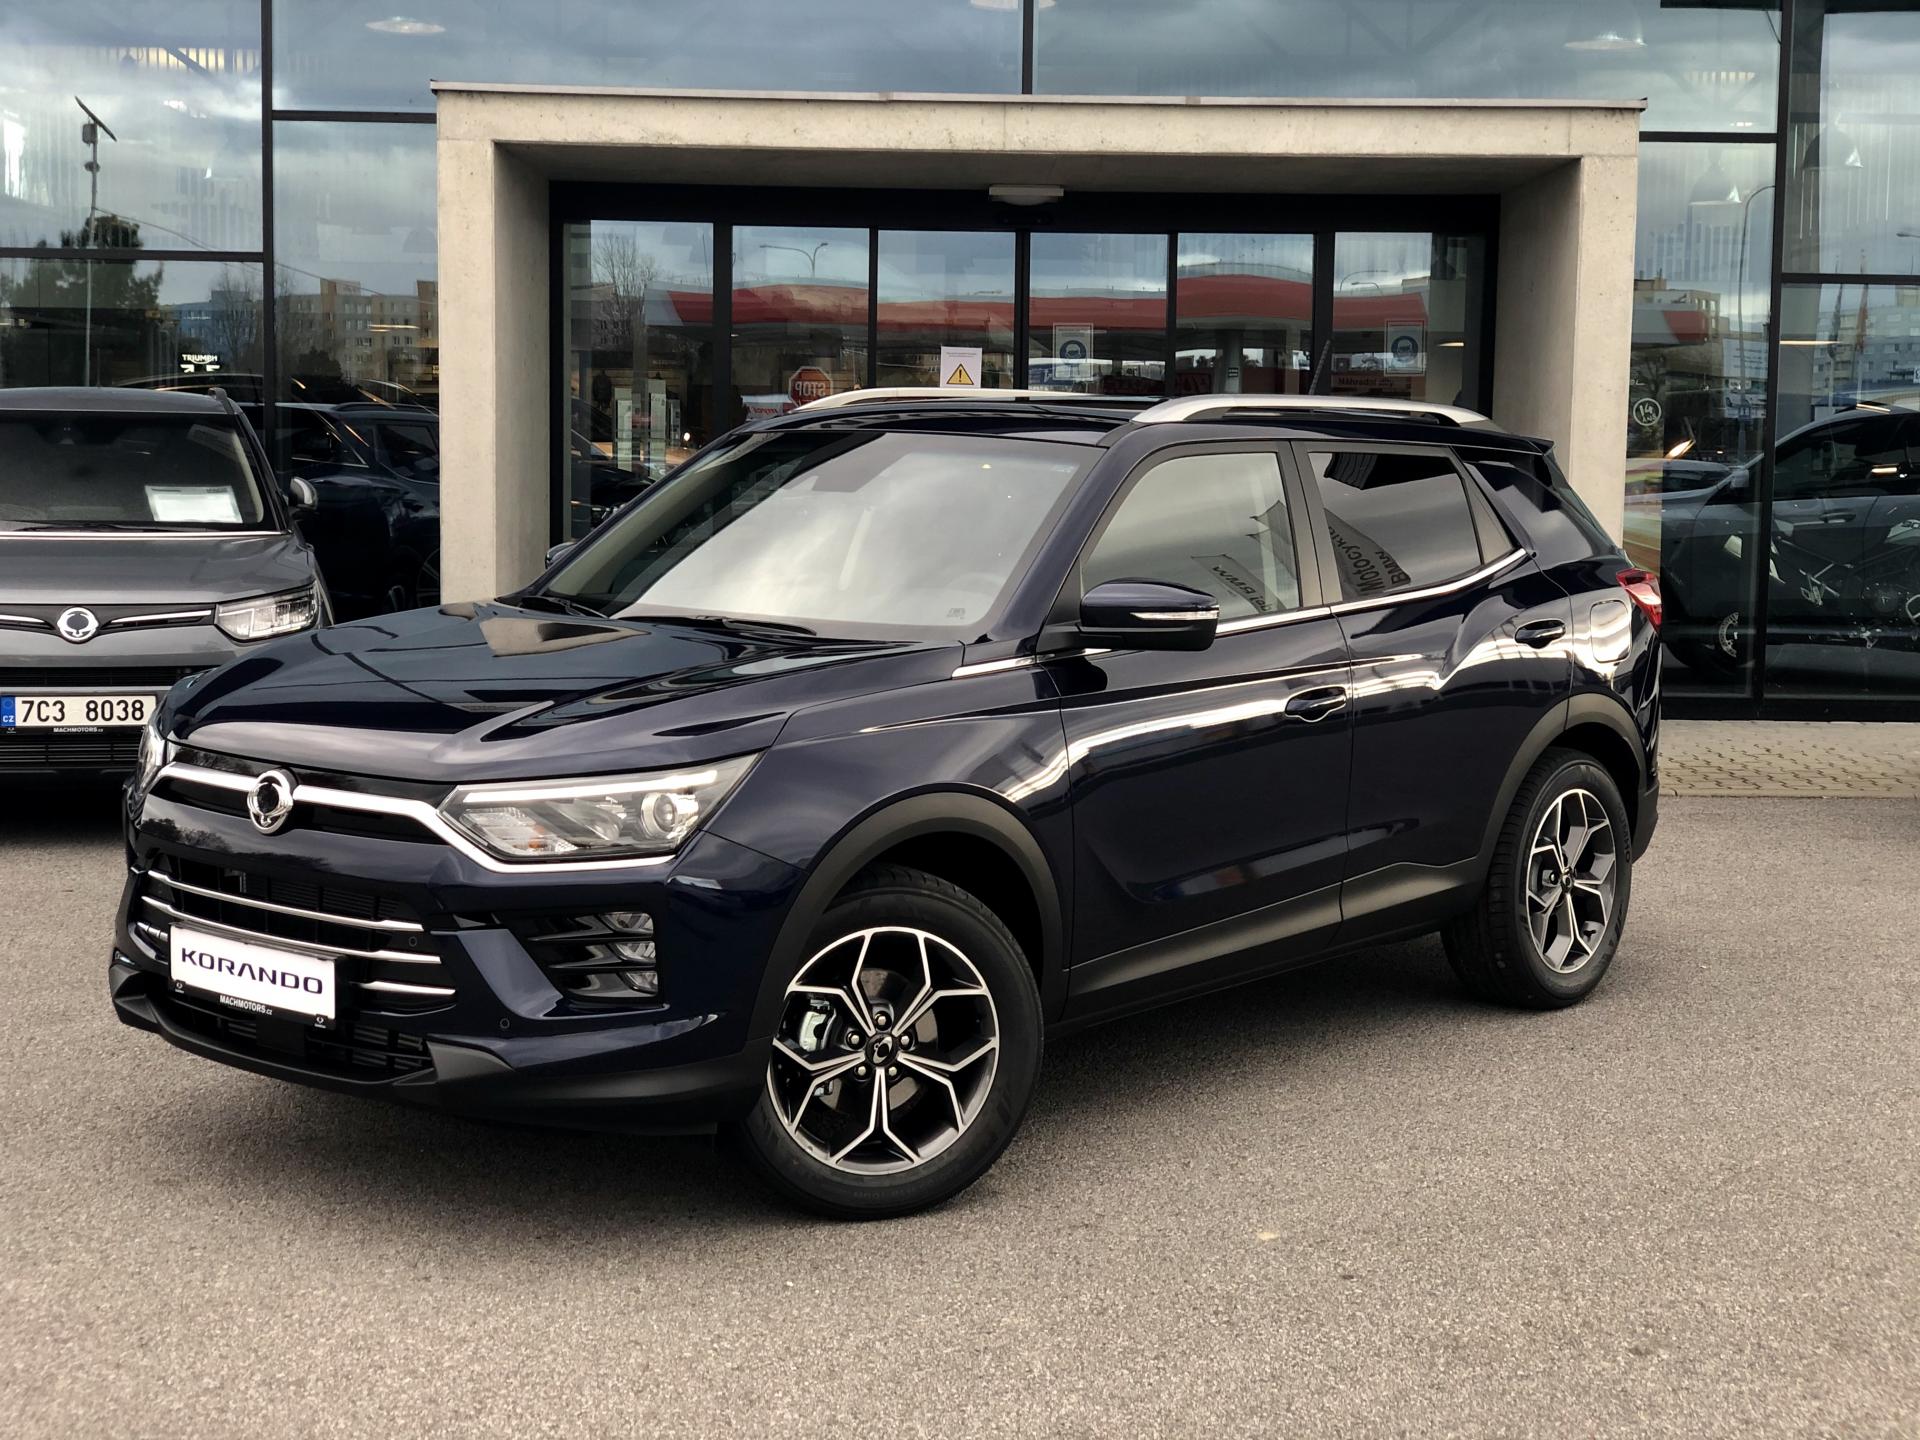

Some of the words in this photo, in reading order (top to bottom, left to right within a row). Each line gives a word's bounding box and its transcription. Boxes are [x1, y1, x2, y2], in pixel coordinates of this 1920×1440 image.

[181, 354, 218, 364] TRIUMPH
[21, 700, 65, 722] 7C3
[86, 700, 144, 722] 8038
[181, 947, 323, 994] KORANDO
[219, 994, 273, 1016] MACHMOTORS.cz
